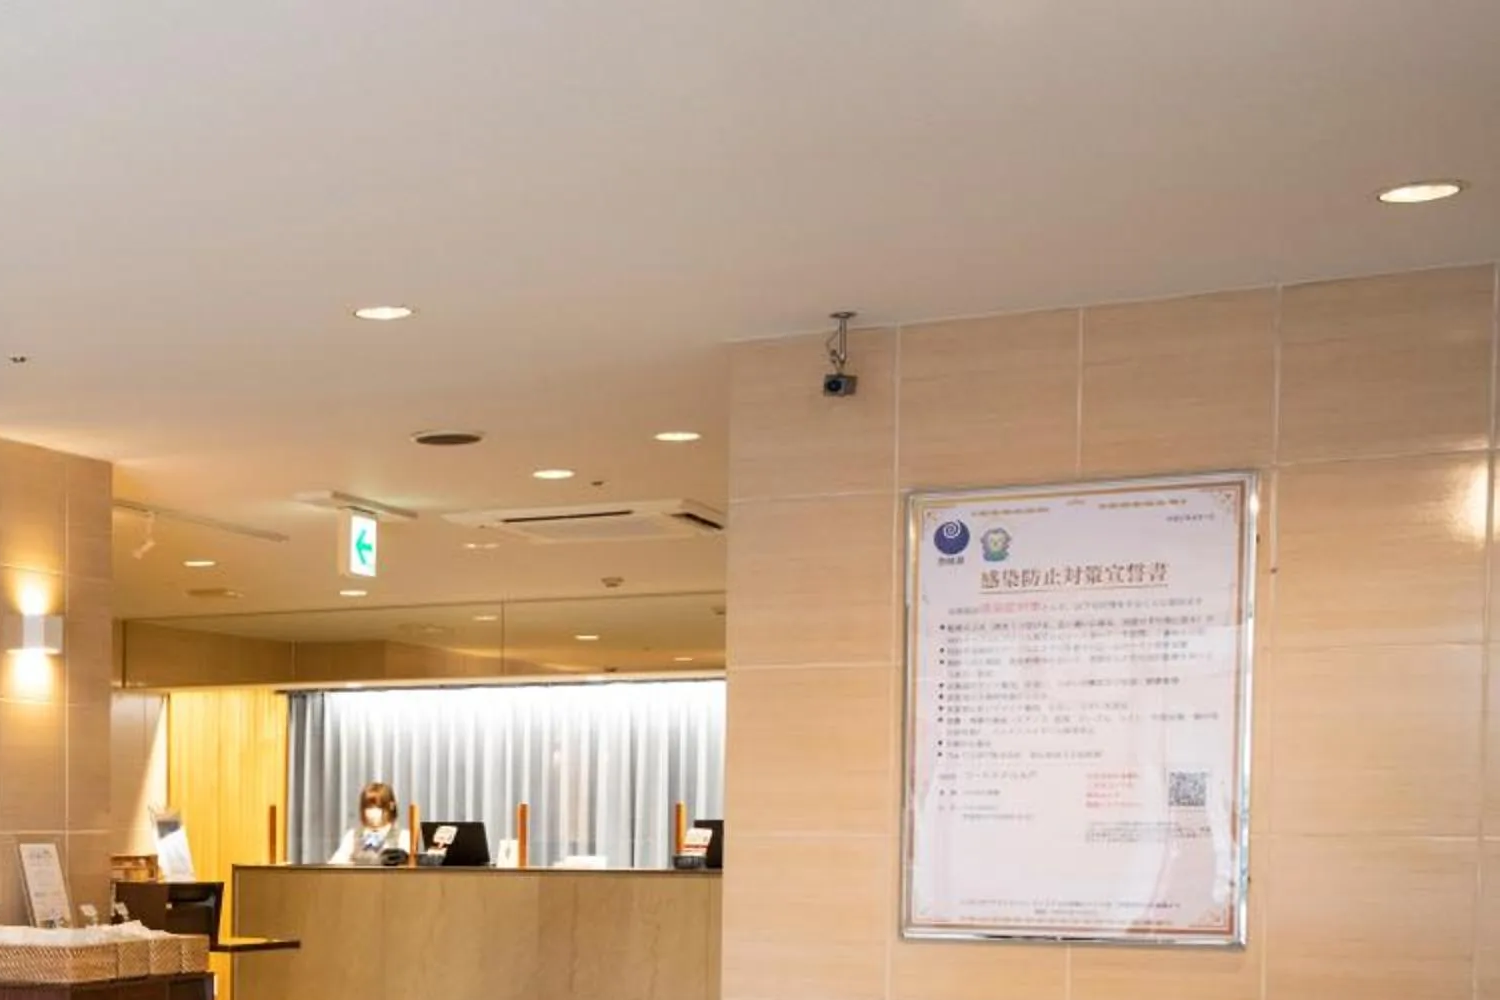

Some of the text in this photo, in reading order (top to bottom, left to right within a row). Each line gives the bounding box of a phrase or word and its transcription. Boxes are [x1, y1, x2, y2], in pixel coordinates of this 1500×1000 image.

[980, 562, 1169, 589] 感染防止対策宣誓書
